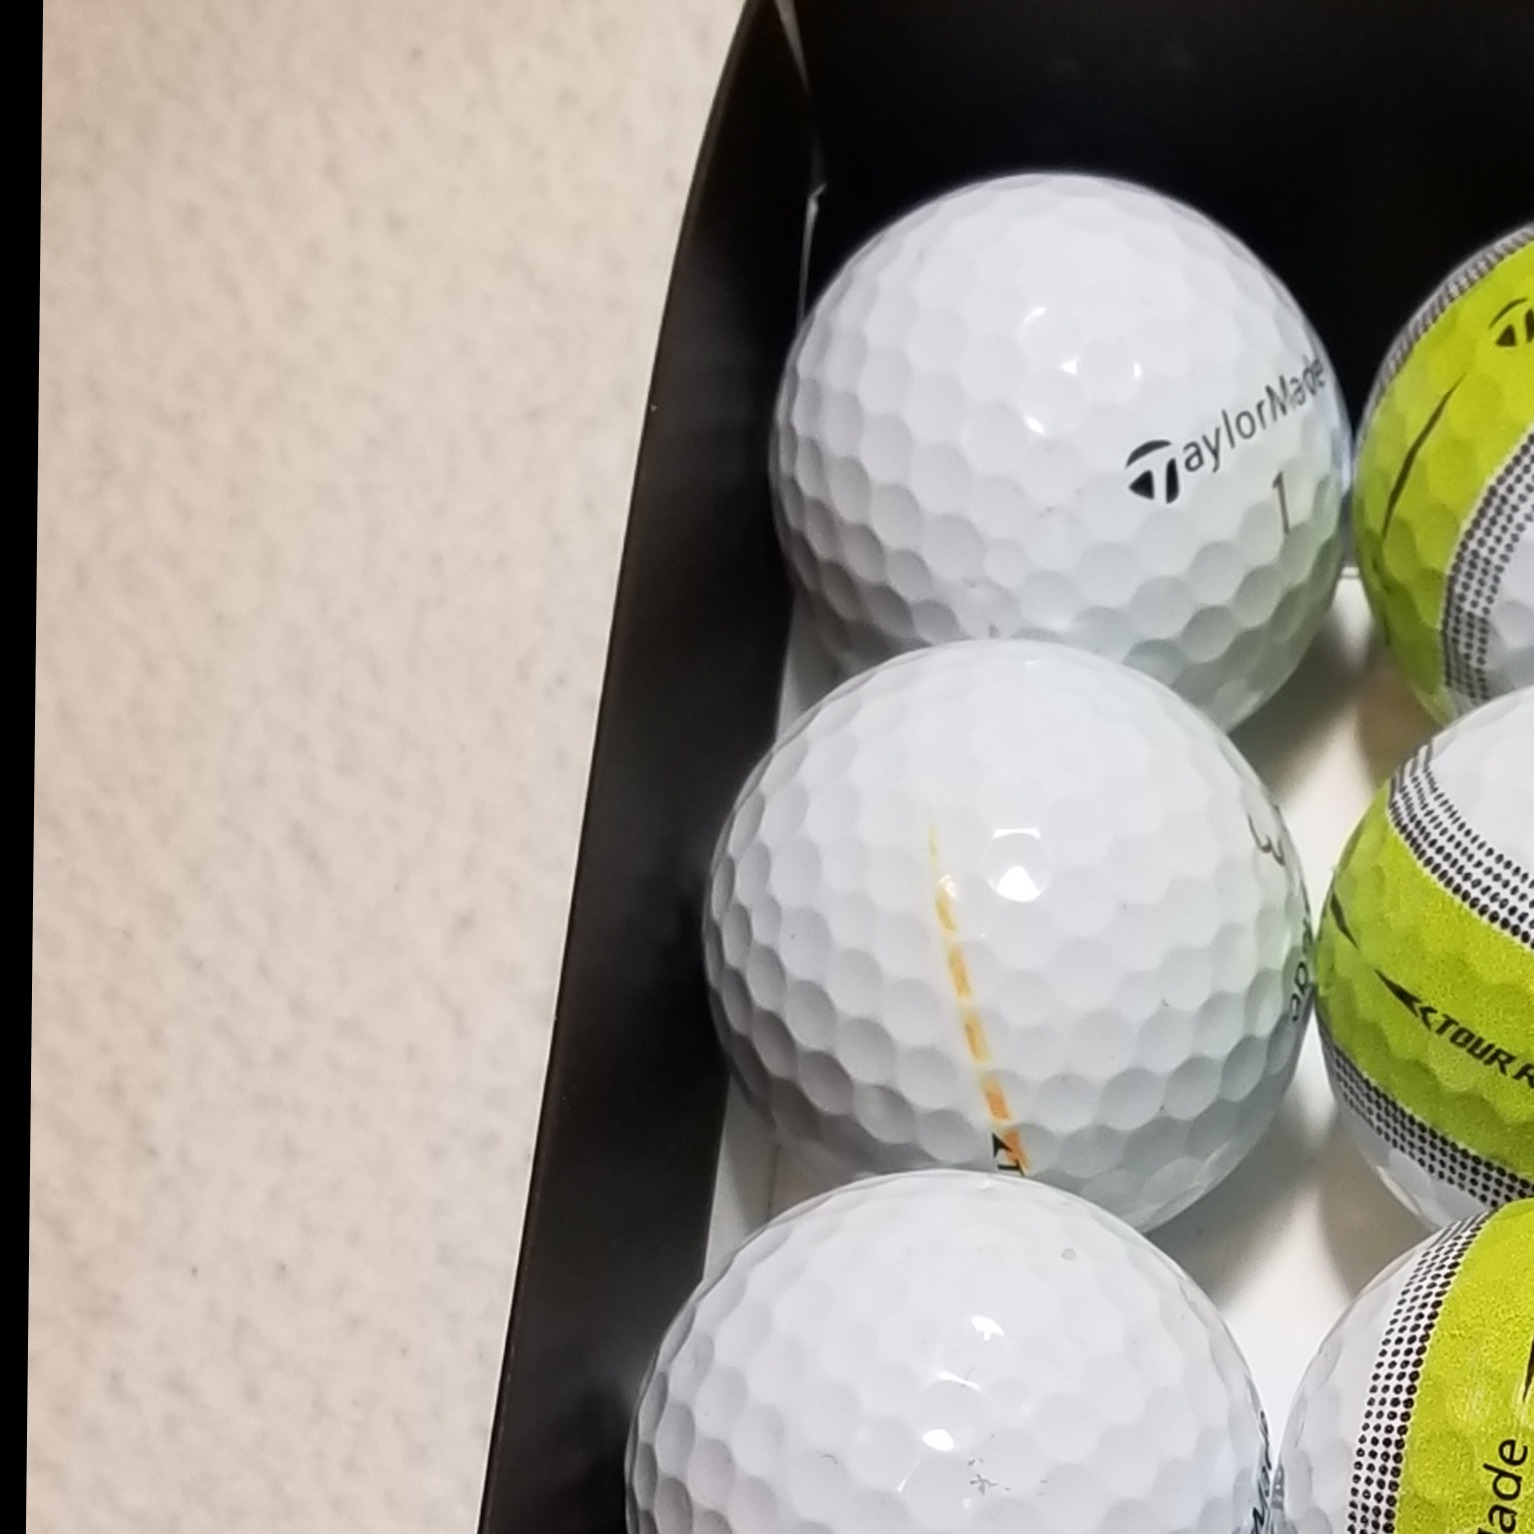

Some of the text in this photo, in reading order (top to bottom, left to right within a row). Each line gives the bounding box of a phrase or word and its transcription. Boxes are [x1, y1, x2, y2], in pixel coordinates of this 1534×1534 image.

[1125, 354, 1326, 504] TaylorMade
[1272, 472, 1290, 534] 1
[1434, 1013, 1517, 1075] TOUR
